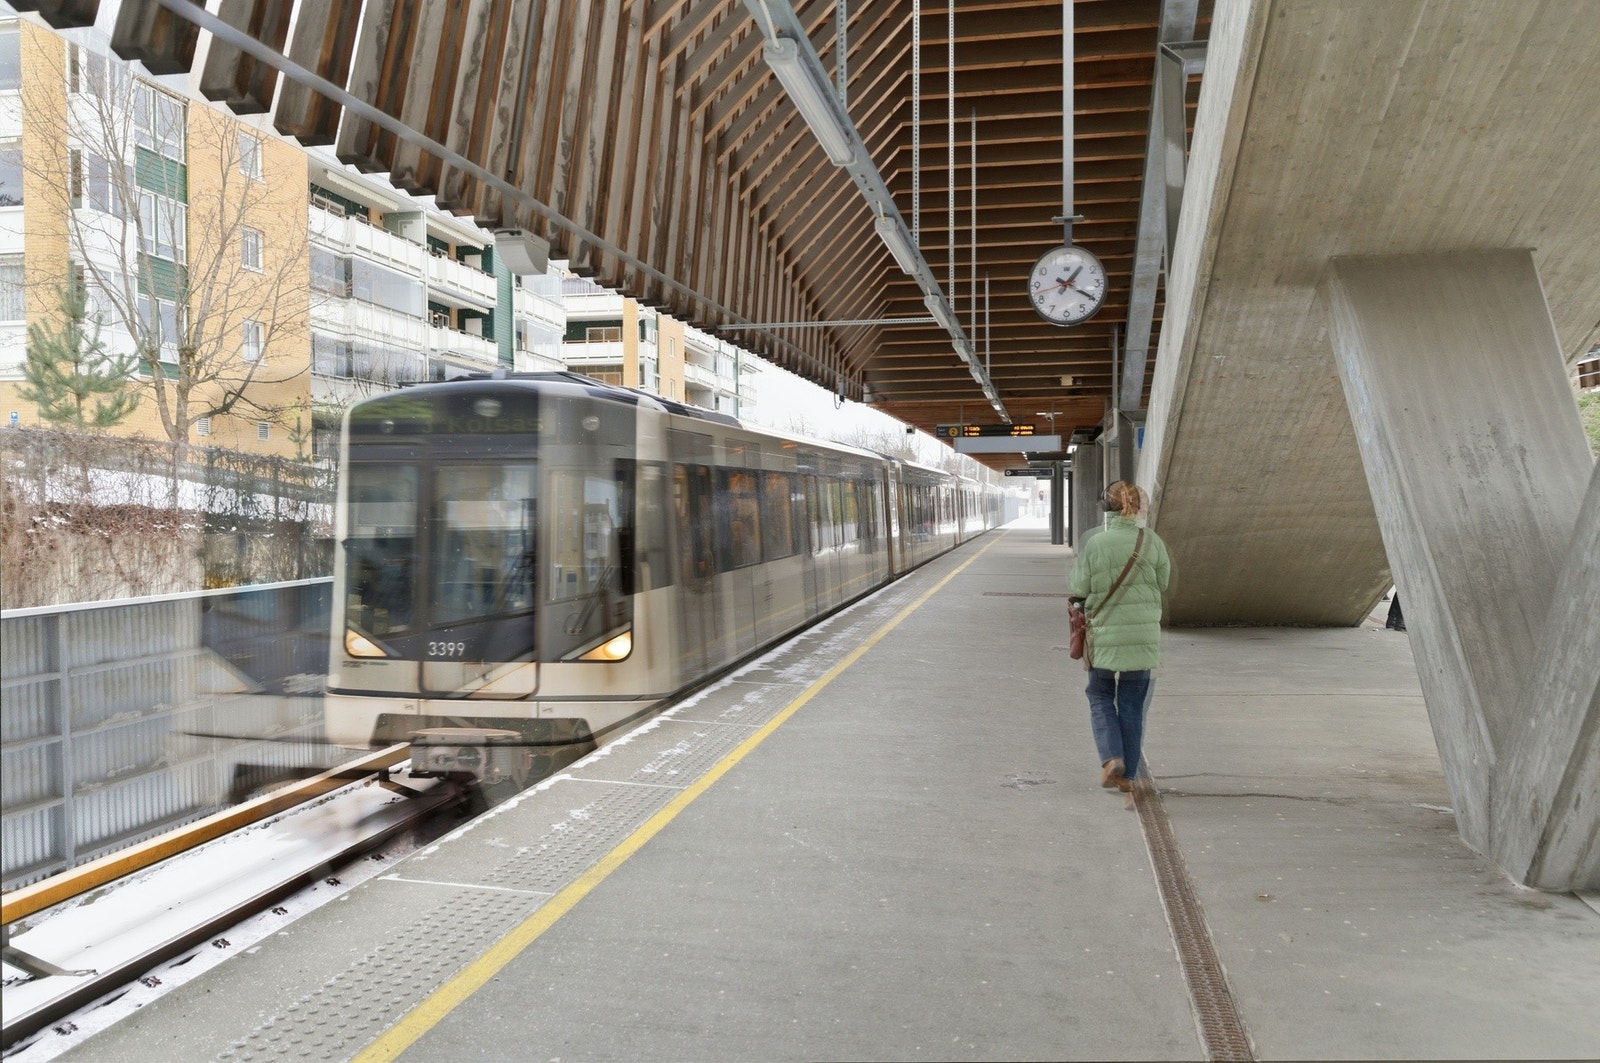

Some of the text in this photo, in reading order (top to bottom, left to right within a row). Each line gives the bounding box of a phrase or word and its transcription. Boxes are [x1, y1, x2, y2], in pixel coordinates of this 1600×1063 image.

[1089, 265, 1096, 274] 2
[1034, 281, 1040, 290] 9
[1094, 279, 1100, 288] 3
[1038, 295, 1045, 304] 8
[1049, 305, 1055, 313] 7
[1079, 304, 1086, 313] 5
[428, 641, 465, 657] 3399
